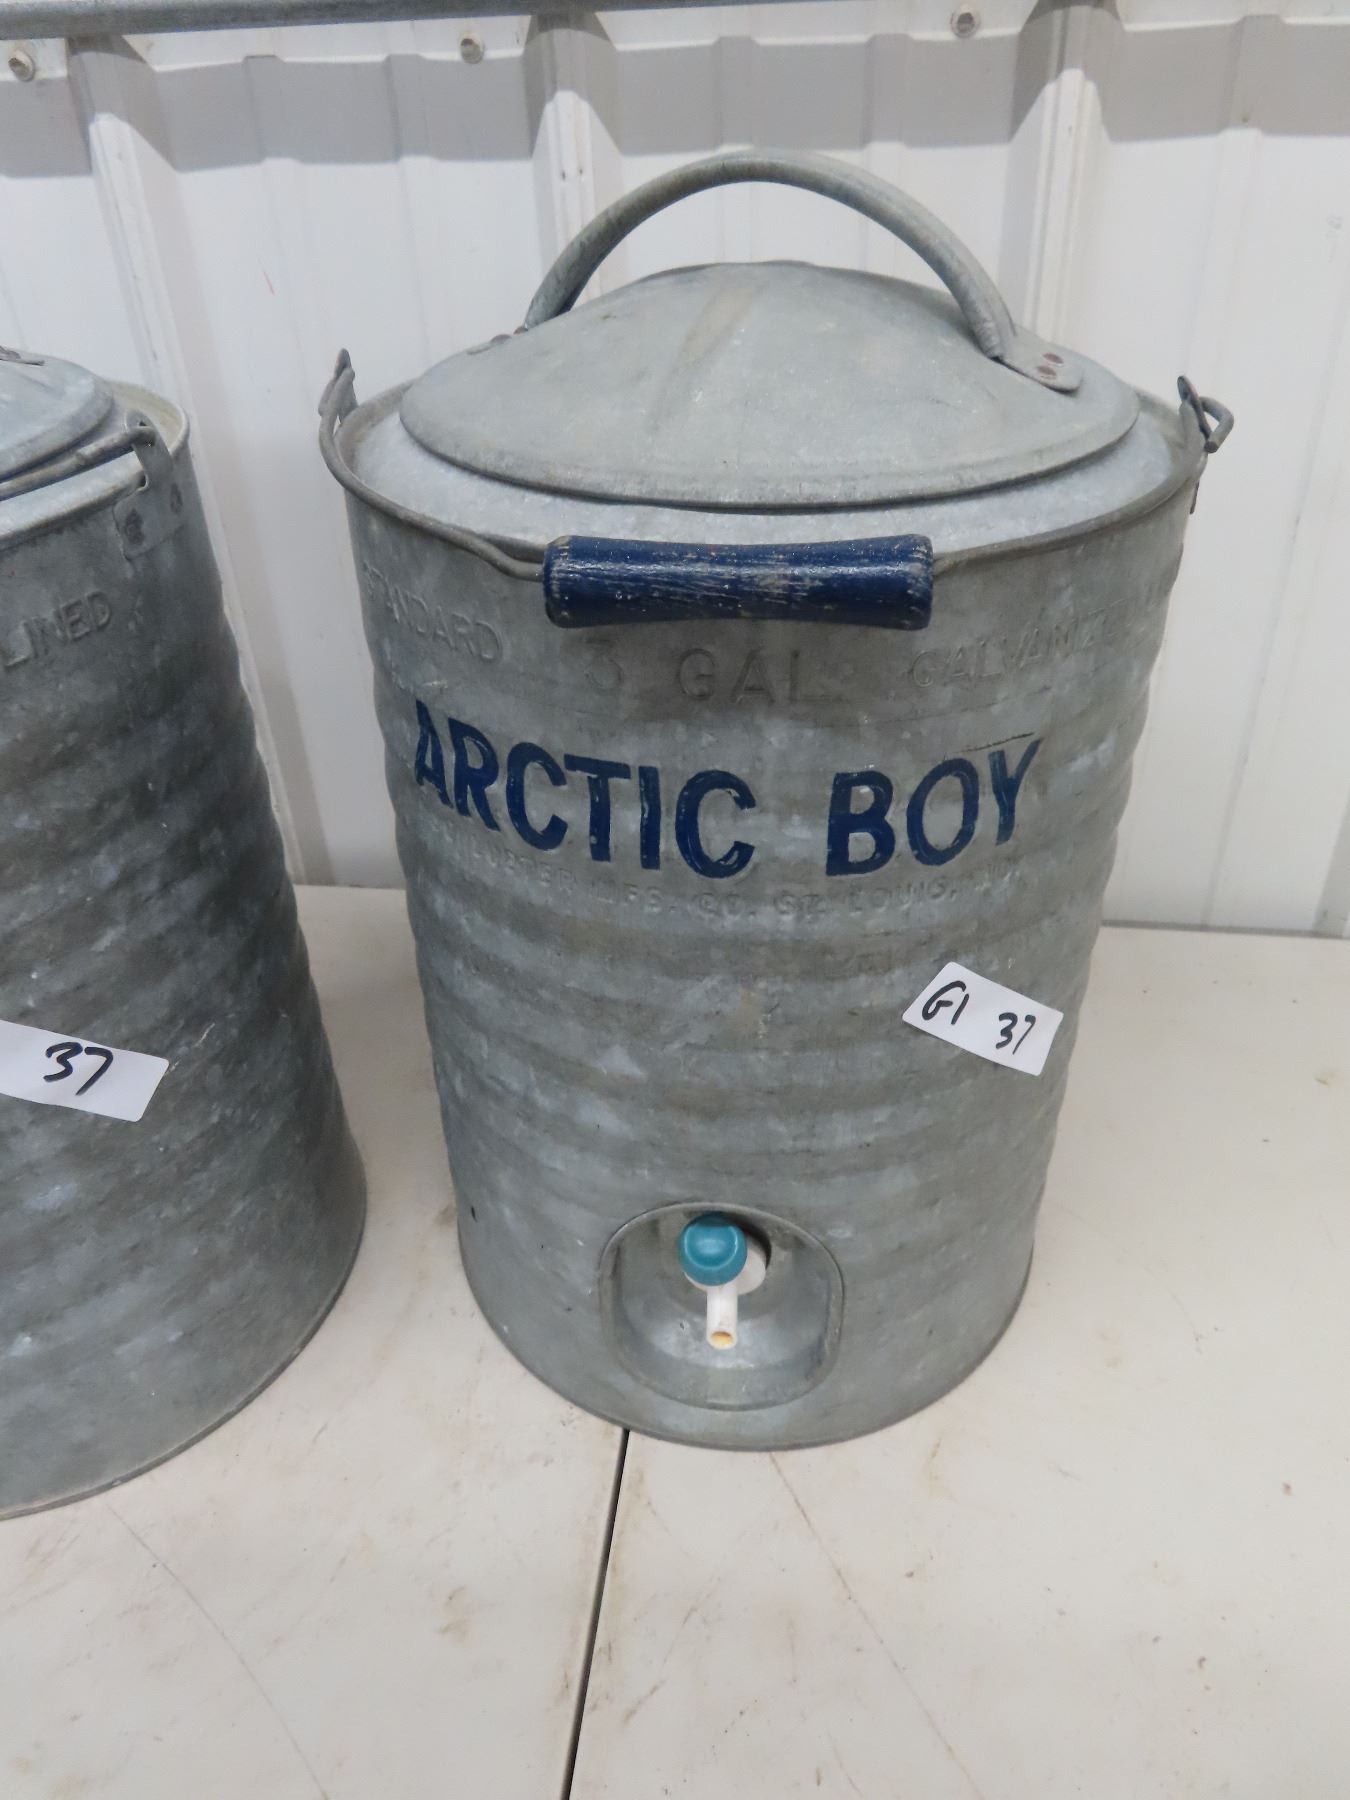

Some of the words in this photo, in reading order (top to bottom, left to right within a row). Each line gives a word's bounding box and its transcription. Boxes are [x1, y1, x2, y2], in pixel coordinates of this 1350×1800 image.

[414, 699, 757, 879] ARCTIC
[825, 737, 1044, 877] BOY
[995, 1012, 1037, 1055] 37
[43, 1041, 114, 1096] 37
